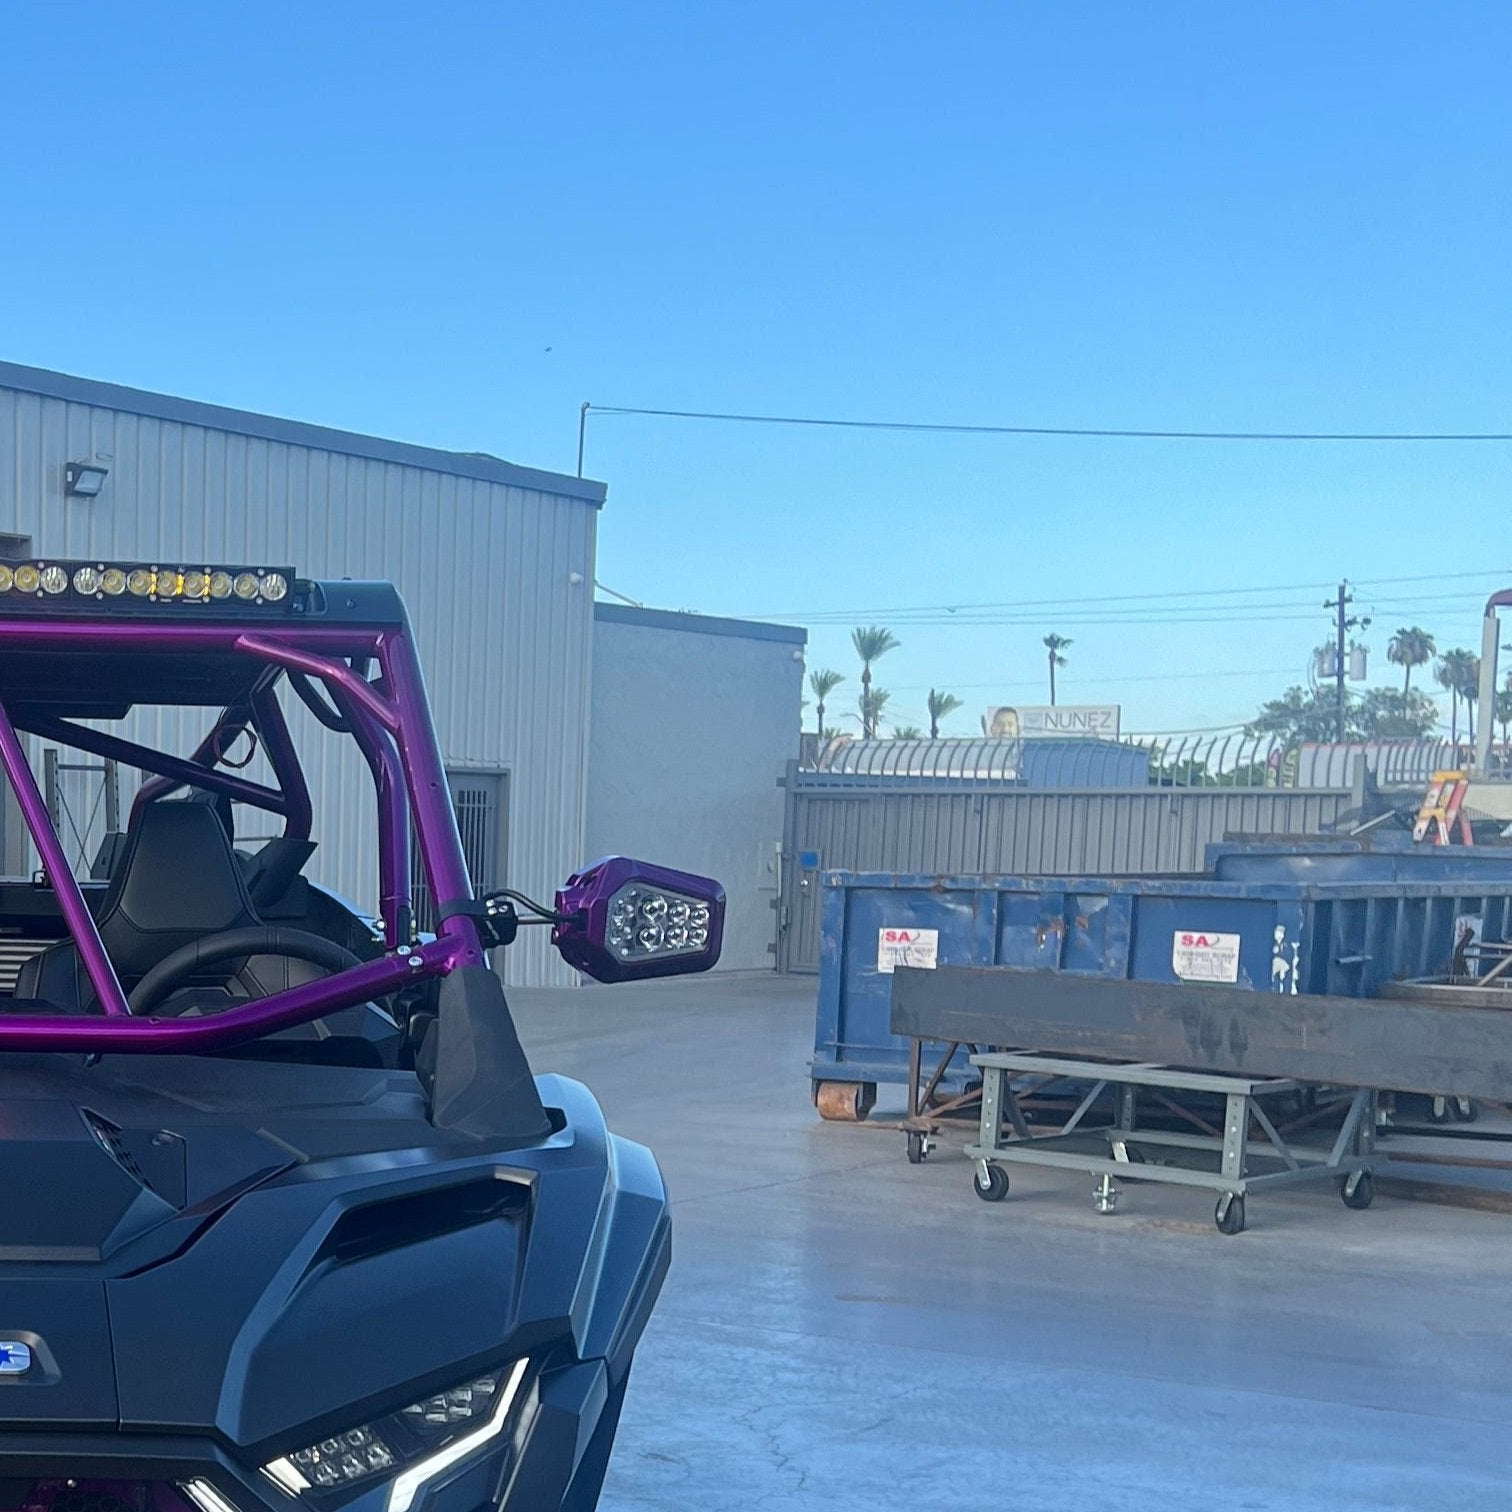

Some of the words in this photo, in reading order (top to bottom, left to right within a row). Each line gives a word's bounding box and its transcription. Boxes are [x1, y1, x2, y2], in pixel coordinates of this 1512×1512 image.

[1044, 711, 1112, 729] NUNEZ
[885, 930, 910, 942] SA
[1181, 934, 1209, 947] SA
